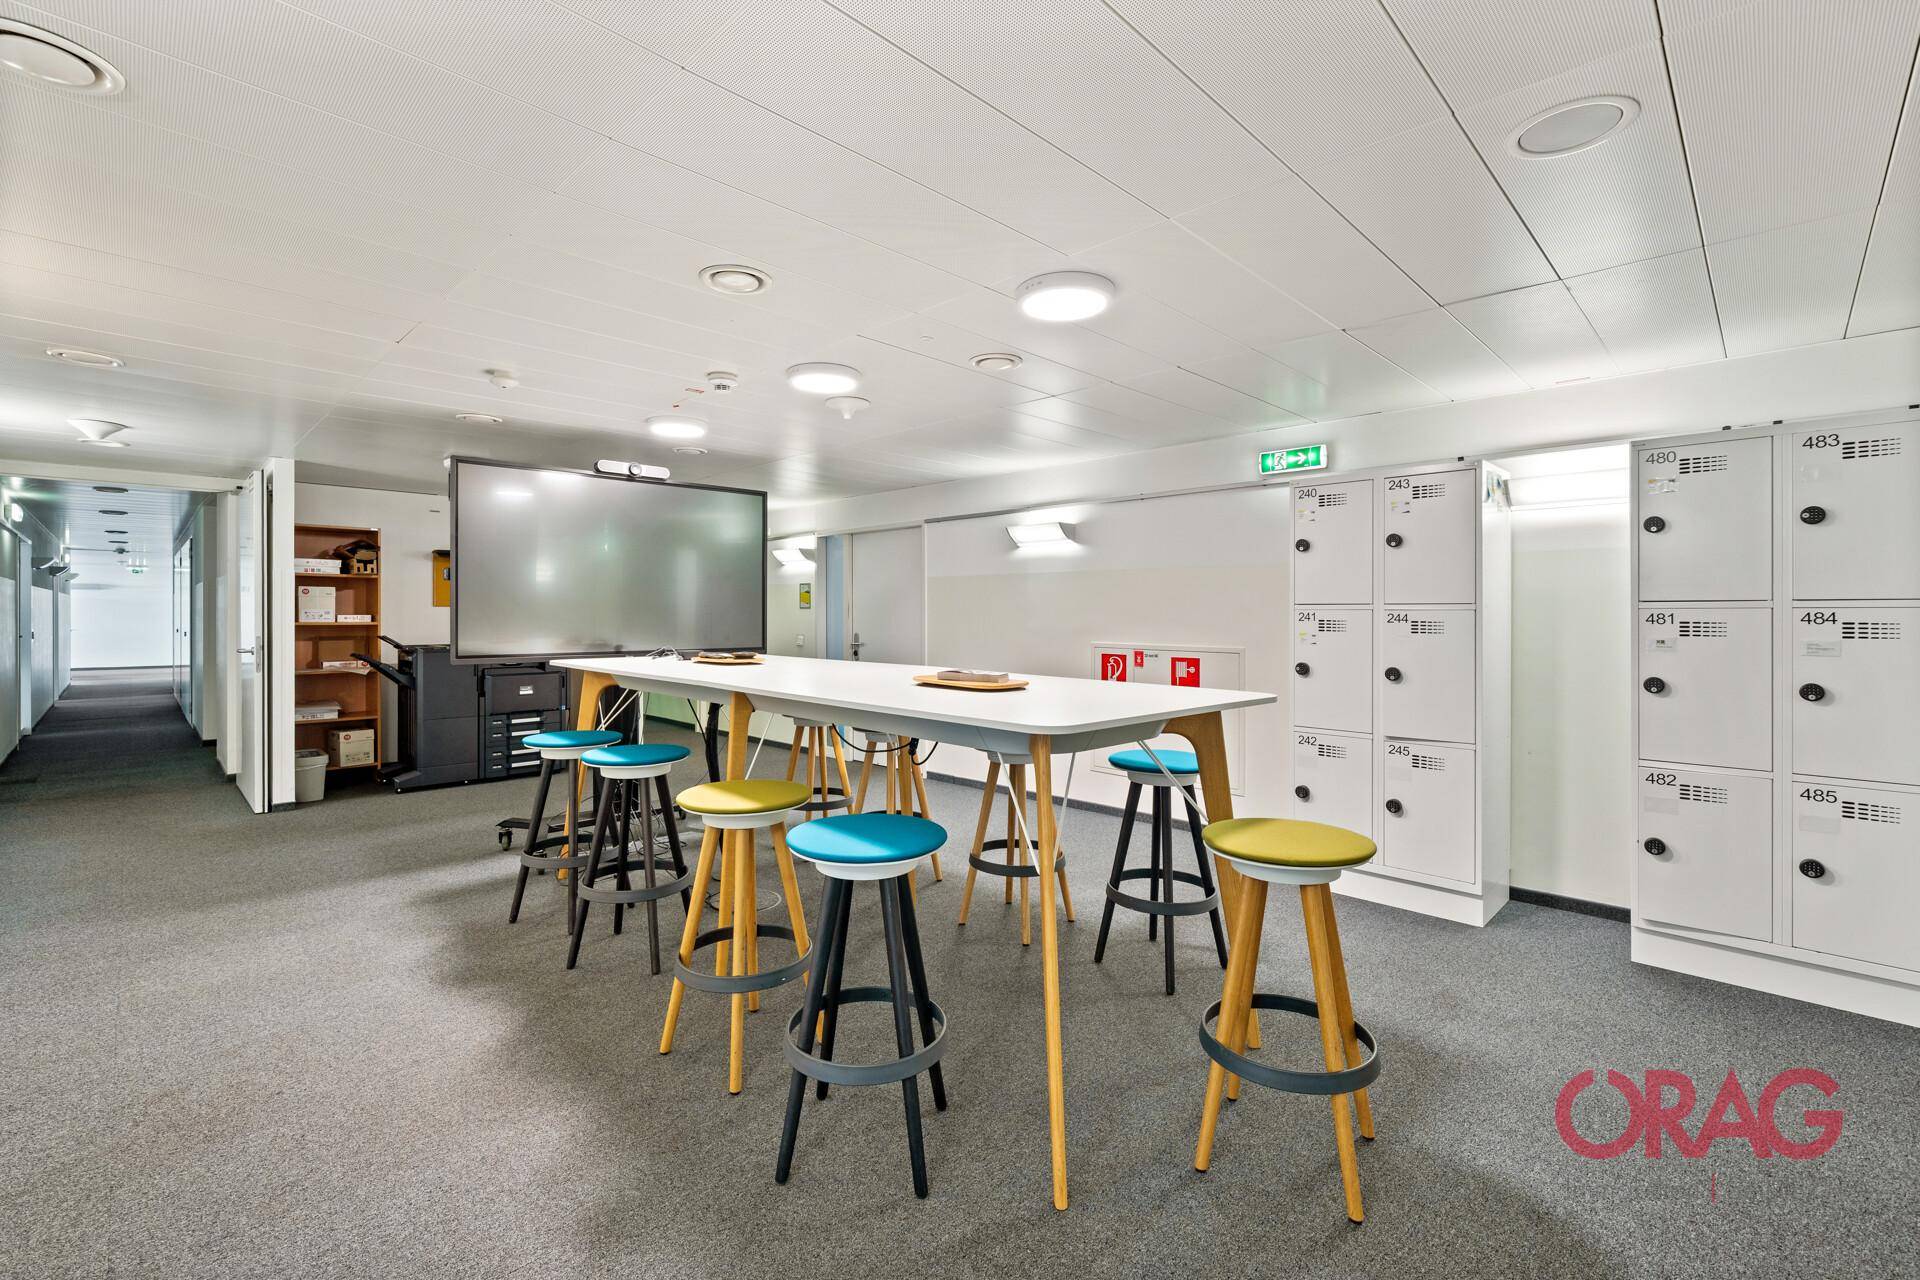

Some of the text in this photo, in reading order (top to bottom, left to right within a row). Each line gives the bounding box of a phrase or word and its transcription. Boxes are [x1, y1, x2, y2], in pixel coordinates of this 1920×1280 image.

[1802, 434, 1840, 449] 483
[1646, 450, 1676, 464] 480
[1388, 479, 1410, 491] 243
[1298, 488, 1317, 500] 240
[1298, 612, 1316, 622] 241
[1386, 613, 1409, 624] 244
[1645, 613, 1674, 626] 481
[1800, 612, 1838, 625] 484
[1298, 735, 1317, 747] 242
[1388, 744, 1410, 757] 245
[1645, 773, 1676, 787] 482
[1800, 788, 1838, 804] 485
